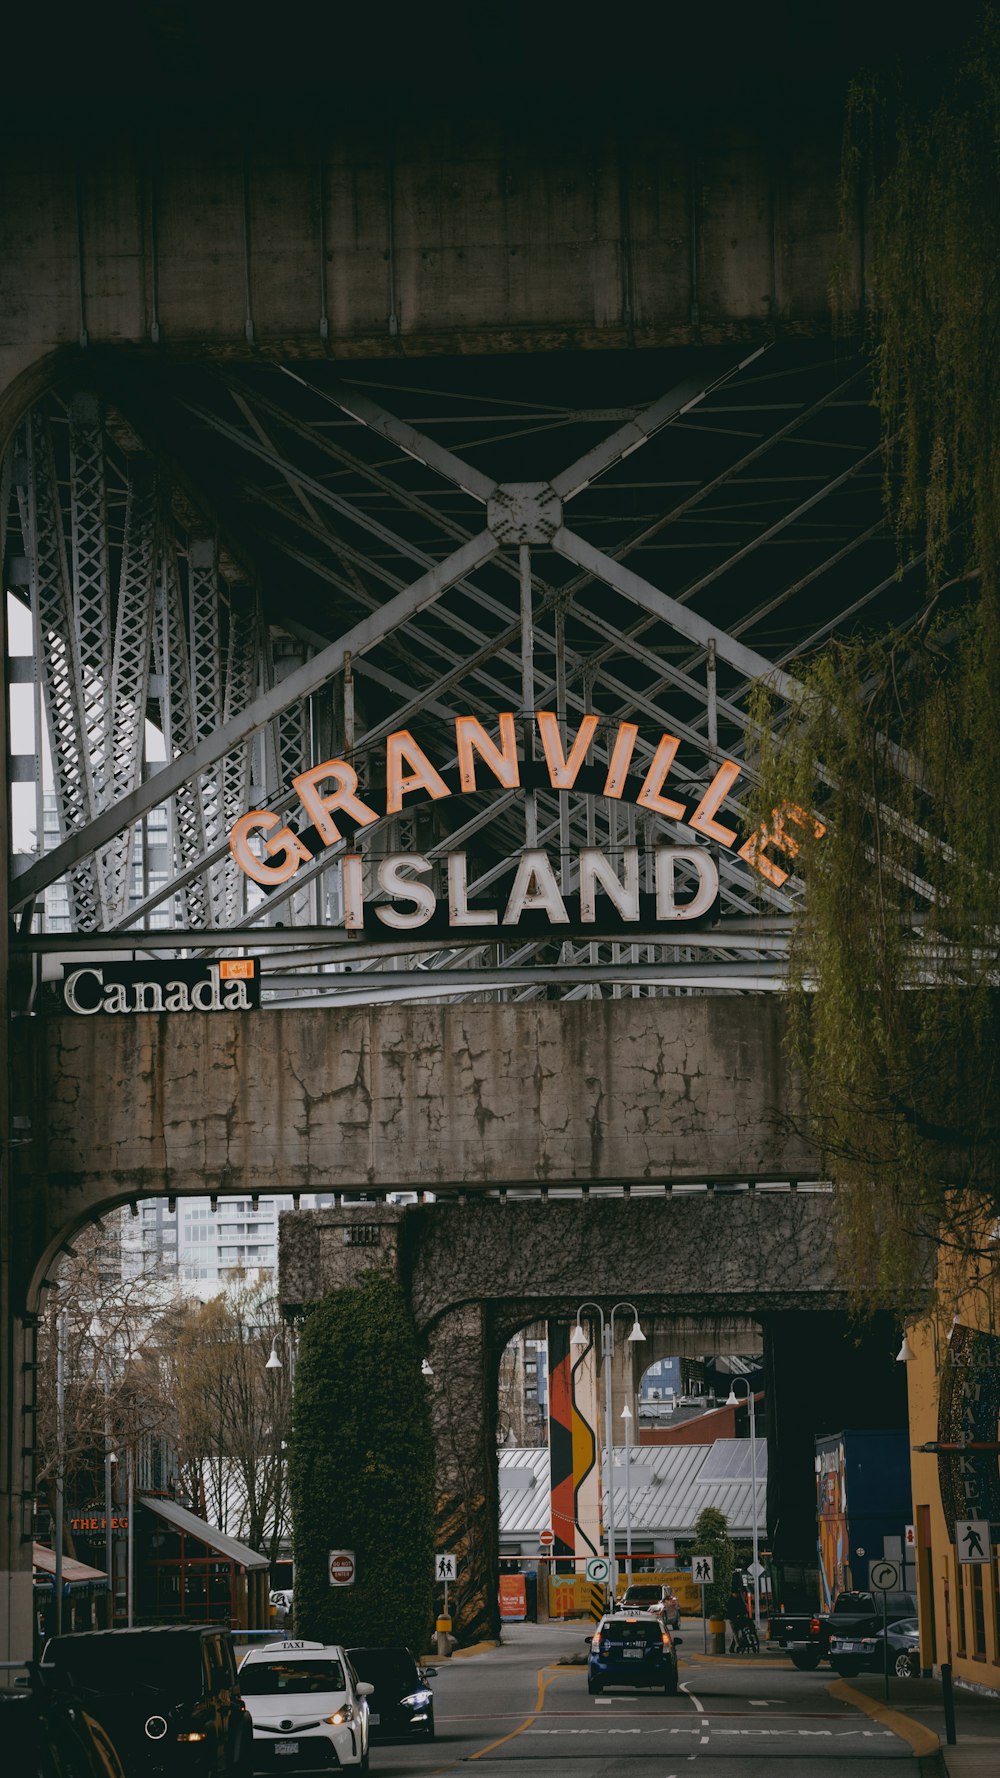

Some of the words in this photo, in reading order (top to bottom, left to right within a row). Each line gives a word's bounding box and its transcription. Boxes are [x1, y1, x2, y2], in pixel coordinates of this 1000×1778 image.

[229, 711, 827, 888] GRANVILLE
[344, 845, 720, 931] ISLAND
[63, 964, 253, 1015] Canada
[70, 1518, 99, 1530] THE
[627, 1610, 641, 1618] TAXI
[281, 1641, 305, 1649] TAXI
[710, 1729, 895, 1737] 30KM/H
